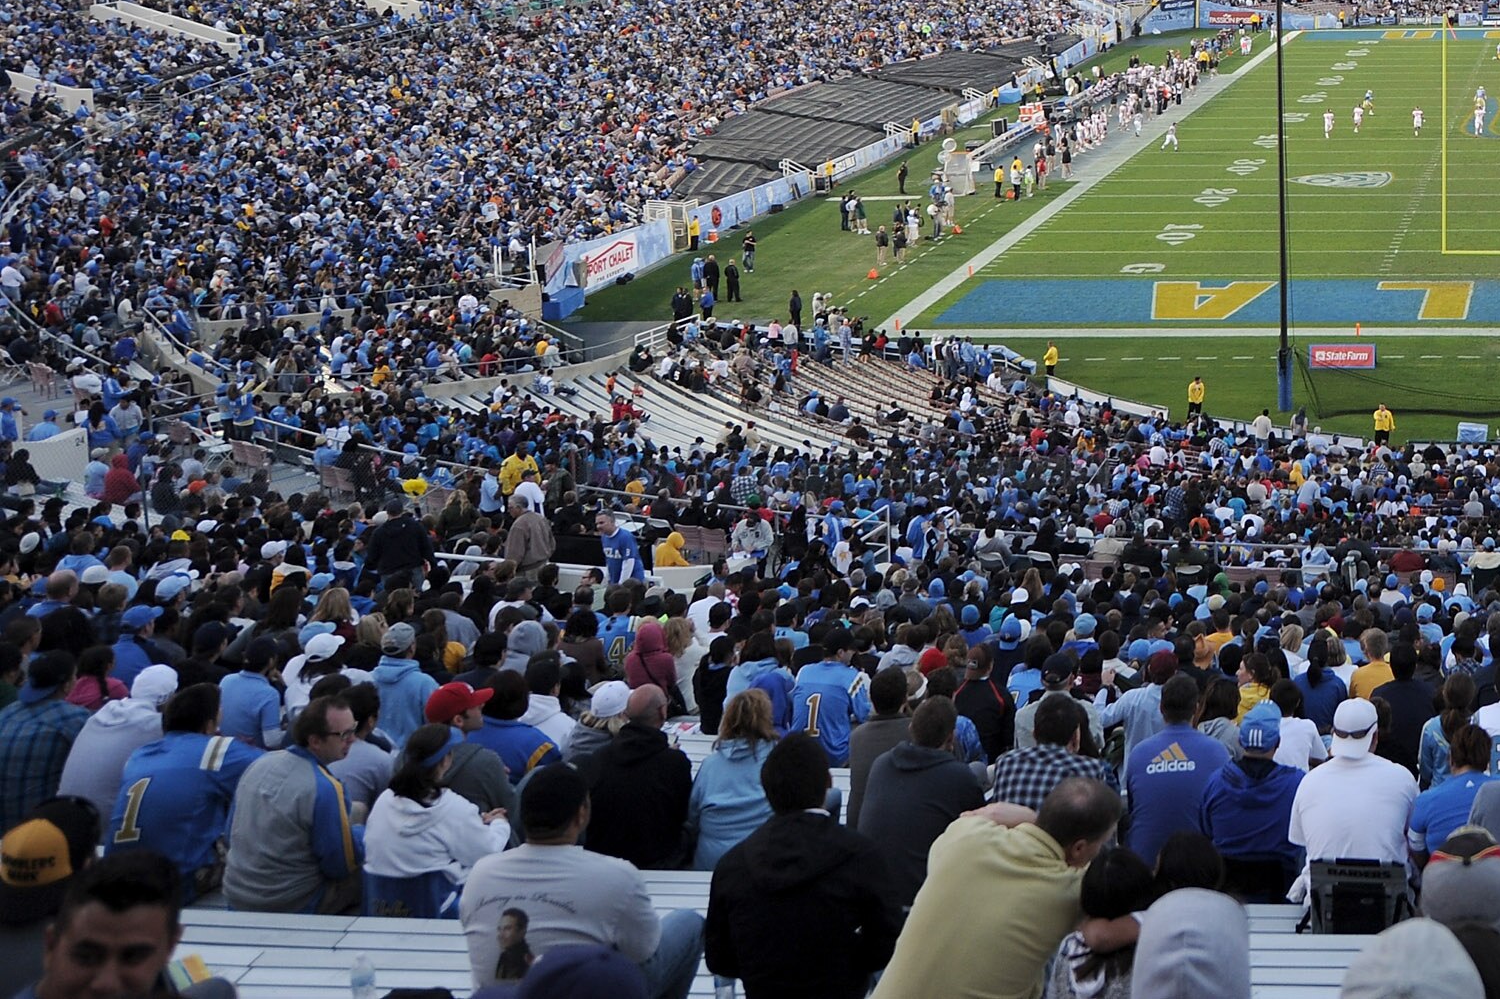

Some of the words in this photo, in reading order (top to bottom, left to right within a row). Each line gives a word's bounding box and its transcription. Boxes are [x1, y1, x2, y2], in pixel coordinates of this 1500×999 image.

[1209, 16, 1235, 24] PASSION
[1226, 159, 1266, 172] 30
[1193, 188, 1238, 203] 20
[1155, 223, 1205, 240] 10
[609, 246, 634, 268] CHALET
[1120, 263, 1165, 274] G
[1325, 351, 1347, 361] State
[1347, 351, 1369, 361] Farm
[75, 436, 85, 447] 24
[804, 692, 822, 738] 1
[1146, 758, 1196, 775] adidas
[113, 777, 152, 845] 1
[1327, 867, 1391, 879] RAIDERS
